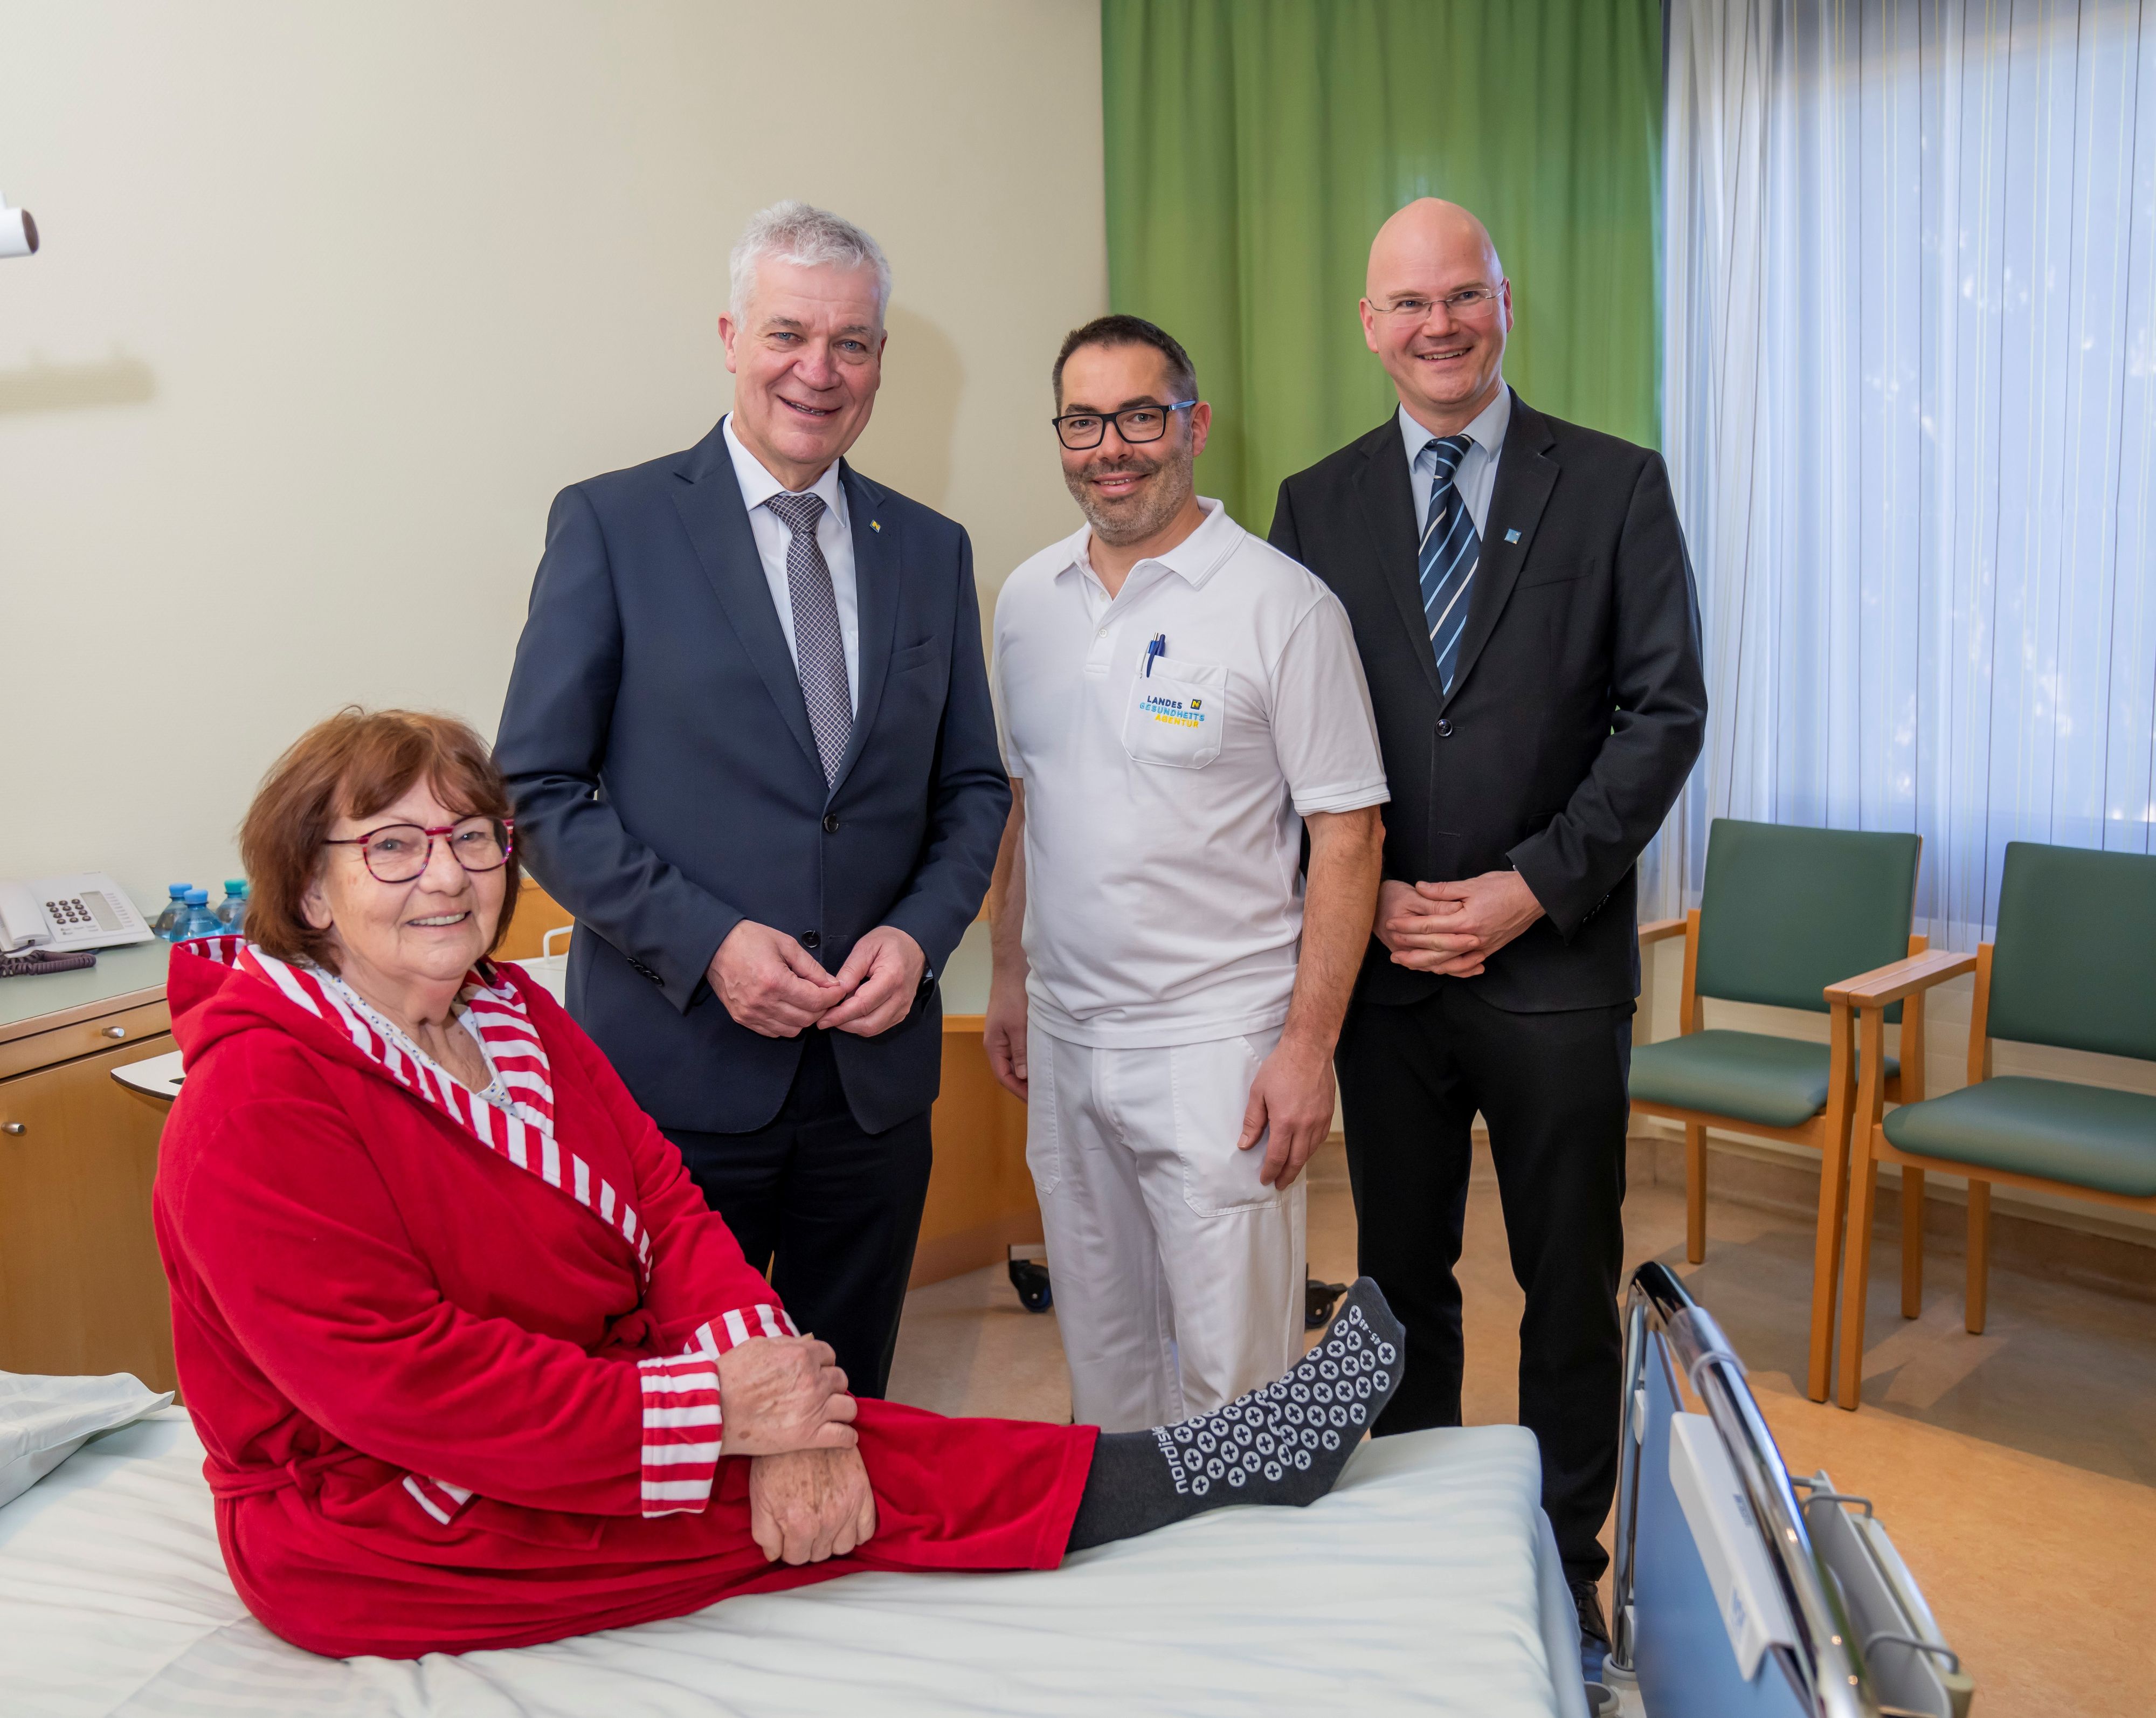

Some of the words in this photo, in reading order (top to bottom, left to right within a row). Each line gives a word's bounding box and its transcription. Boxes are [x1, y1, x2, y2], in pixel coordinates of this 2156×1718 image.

[1146, 695, 1183, 709] LANDES
[1139, 701, 1205, 722] GESUNDHEITS
[1155, 713, 1199, 728] AGENTUR
